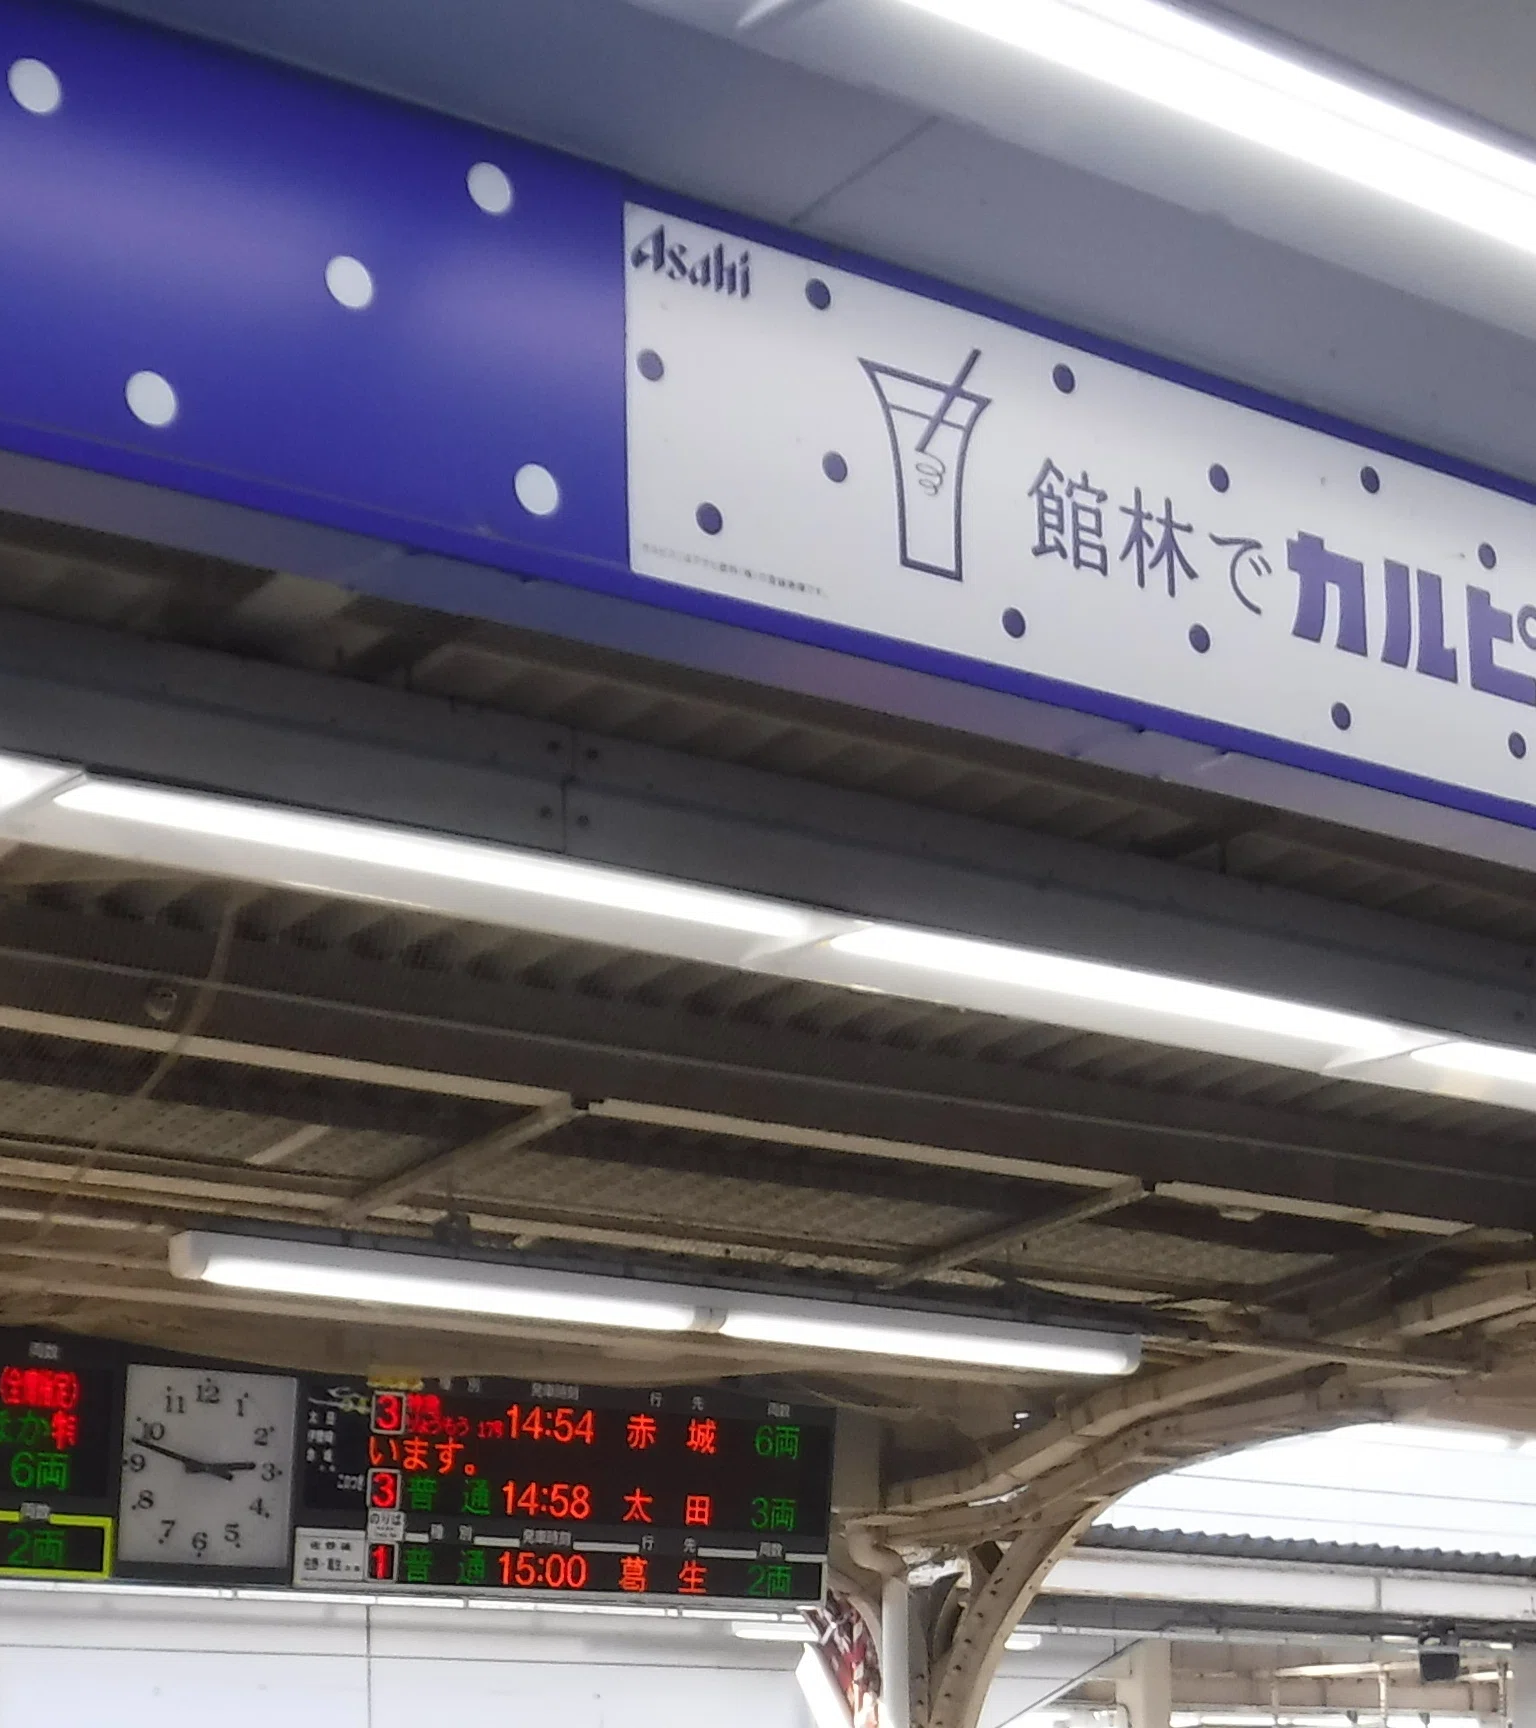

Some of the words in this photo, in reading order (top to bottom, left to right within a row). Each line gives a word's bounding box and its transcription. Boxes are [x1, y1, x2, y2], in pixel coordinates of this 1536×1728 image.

[631, 224, 753, 299] Asahi
[196, 1385, 220, 1404] 12
[166, 1395, 185, 1414] 11
[237, 1399, 245, 1417] 1
[375, 1394, 401, 1430] 3
[142, 1422, 165, 1441] 10
[254, 1427, 269, 1446] 2
[507, 1403, 595, 1443] 14:54
[755, 1424, 801, 1460] 6両
[130, 1454, 145, 1472] 9
[369, 1437, 477, 1475] います。
[11, 1452, 70, 1491] 6両
[262, 1463, 276, 1481] 3
[138, 1490, 154, 1509] 8
[249, 1498, 264, 1516] 4
[372, 1472, 397, 1508] 3
[501, 1480, 591, 1521] 14:58
[751, 1497, 796, 1532] 3両
[161, 1520, 176, 1538] 7
[224, 1523, 240, 1542] 5
[7, 1529, 66, 1567] 2両
[192, 1532, 208, 1550] 6
[371, 1544, 389, 1580] 1
[498, 1551, 587, 1588] 15:00
[747, 1564, 792, 1597] 2両
